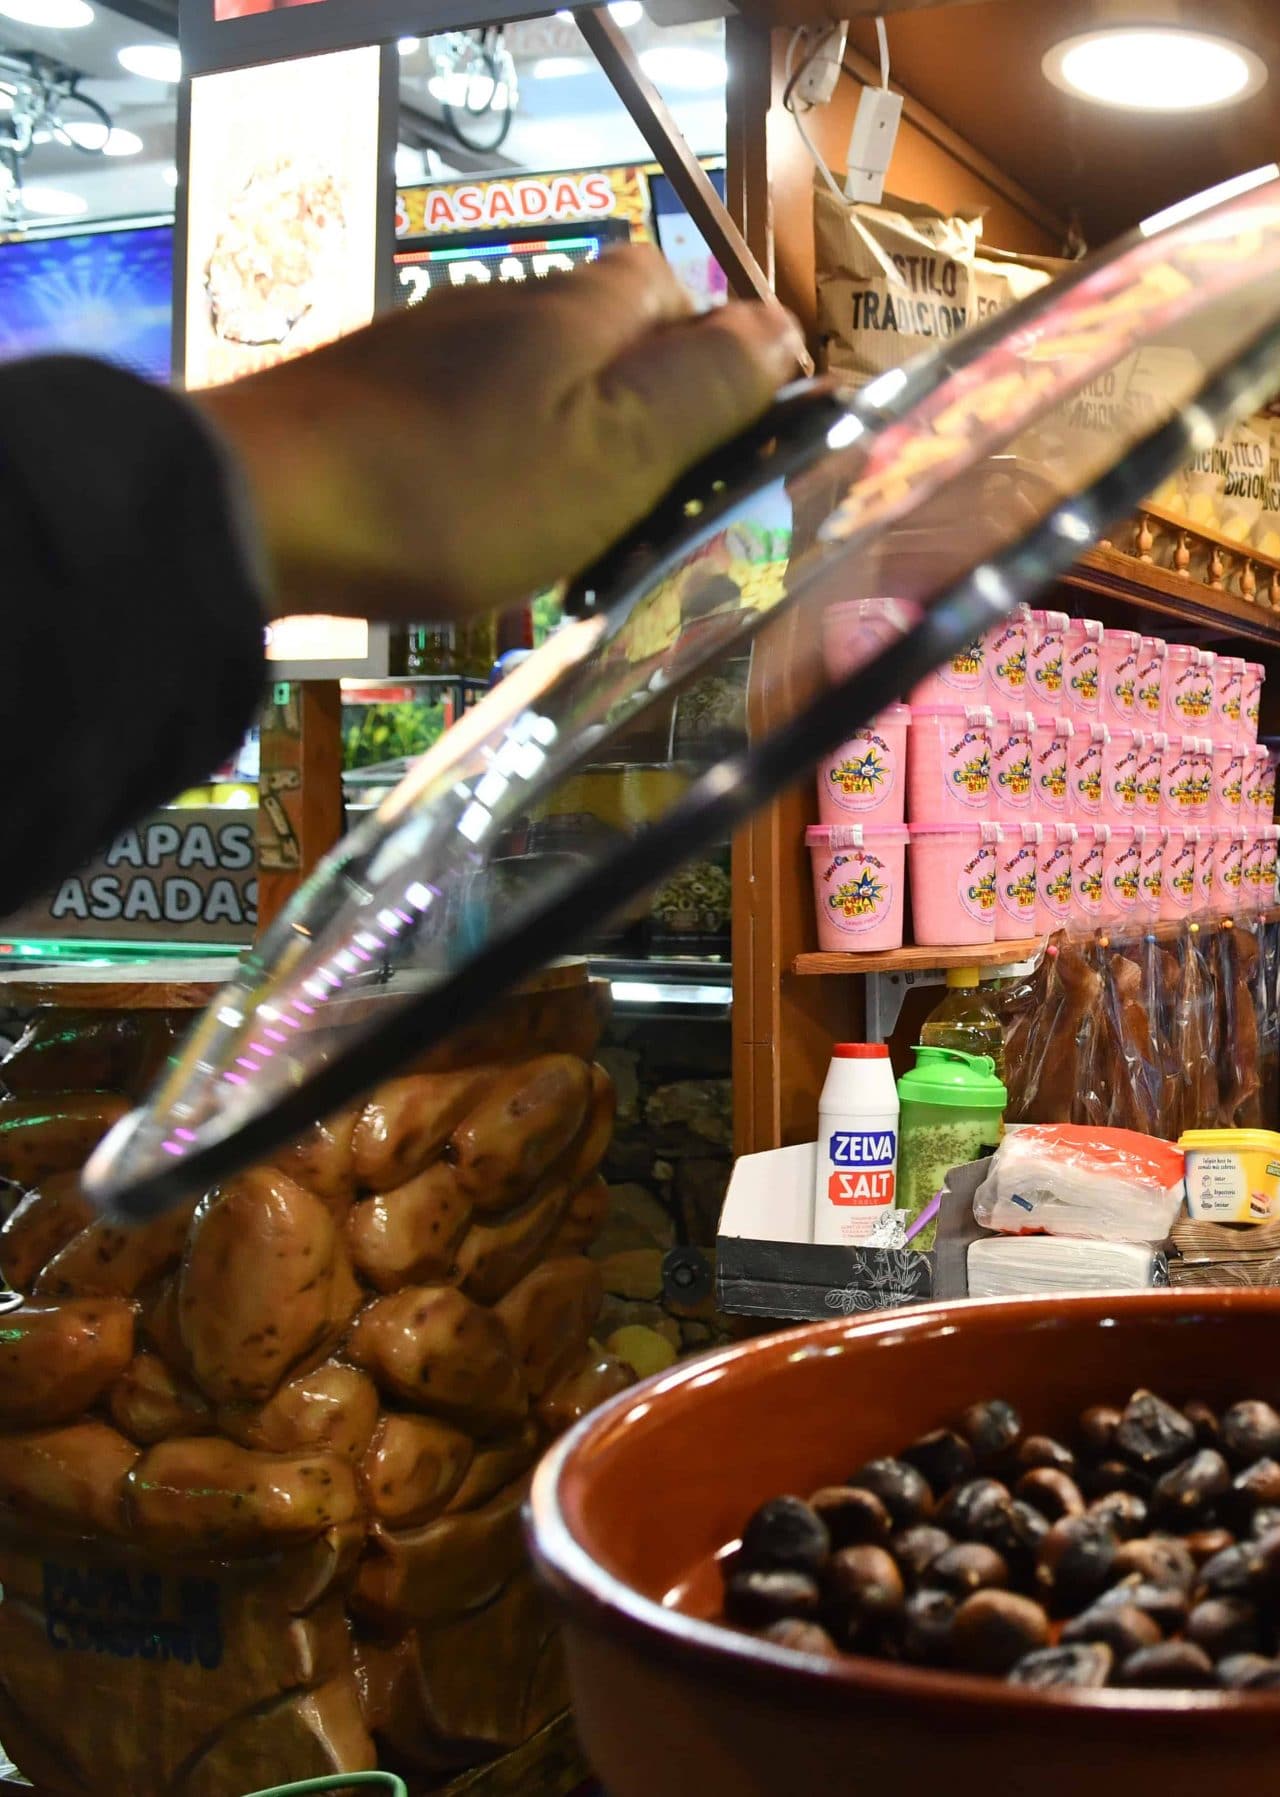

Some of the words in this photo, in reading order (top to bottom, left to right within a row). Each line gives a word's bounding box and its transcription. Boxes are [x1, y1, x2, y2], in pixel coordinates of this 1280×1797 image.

[427, 177, 611, 226] ASADAS
[888, 252, 957, 299] STILO
[852, 290, 966, 338] TRADICION
[105, 824, 252, 869] APAS
[835, 1135, 893, 1161] ZELVA
[838, 1173, 891, 1199] SALT
